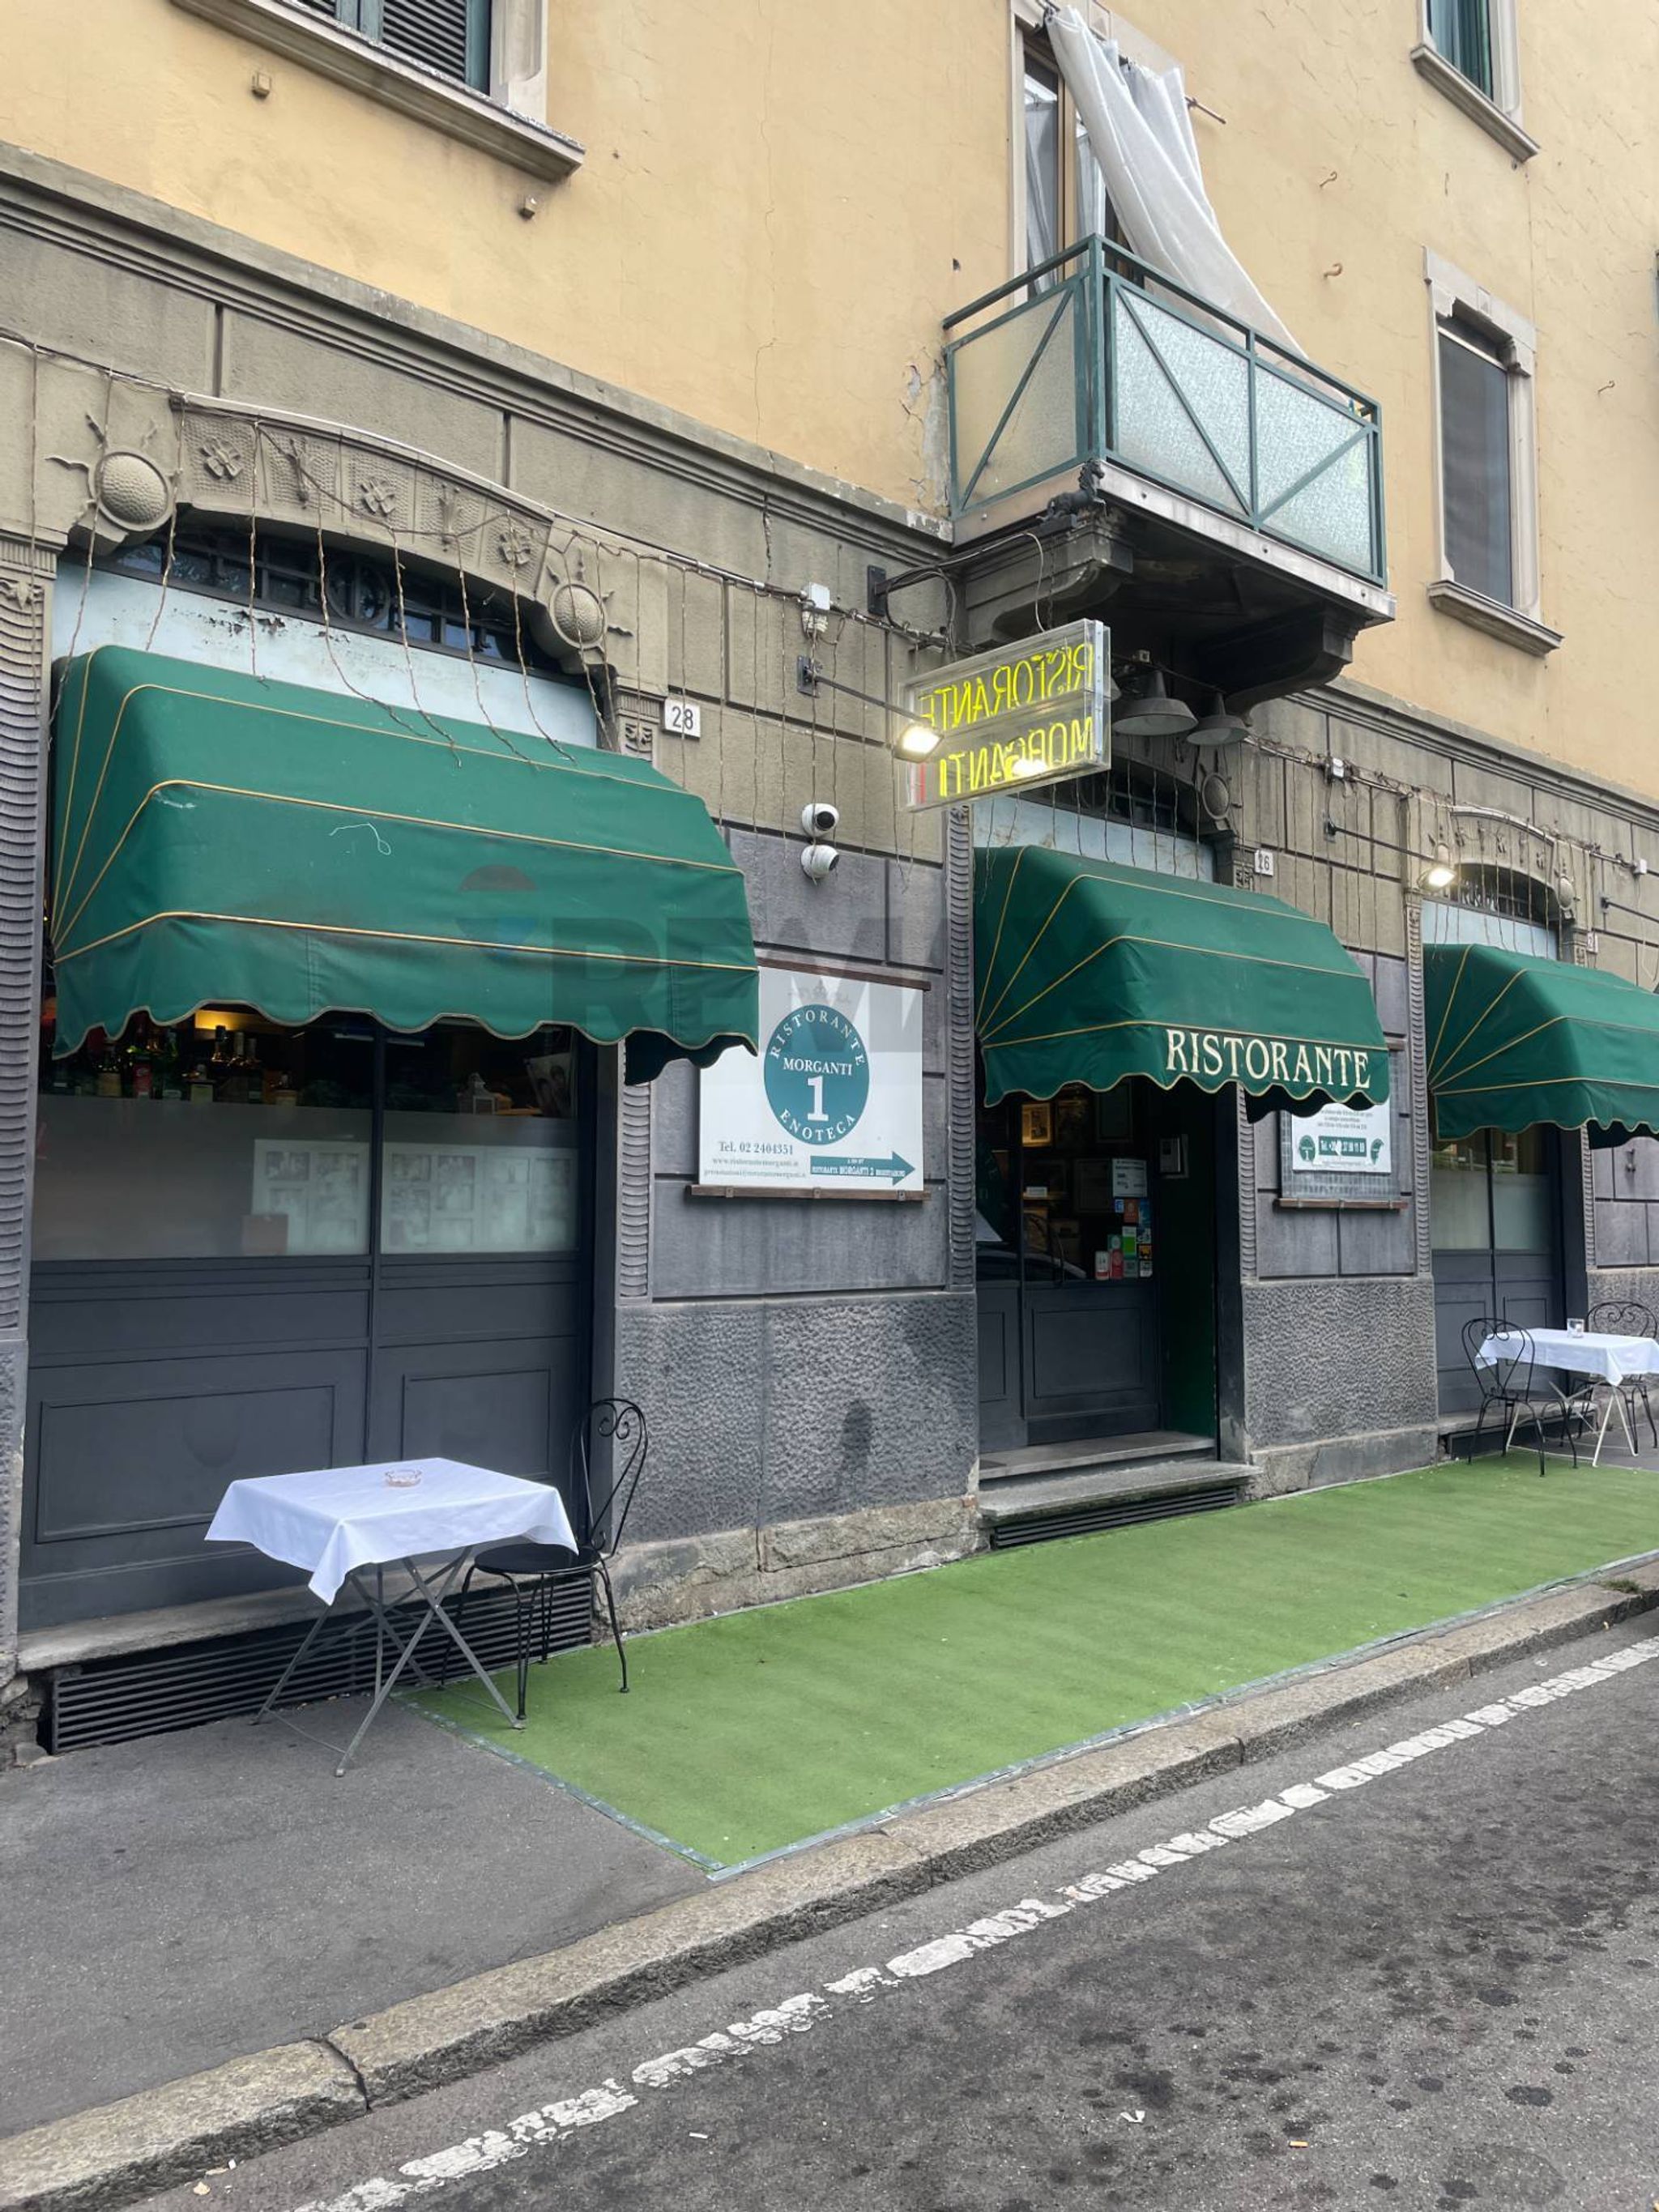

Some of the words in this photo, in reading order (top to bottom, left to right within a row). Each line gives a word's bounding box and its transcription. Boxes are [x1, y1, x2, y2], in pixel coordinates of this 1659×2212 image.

[672, 706, 693, 729] 28
[770, 1009, 866, 1066] RISTORANTE
[783, 1057, 852, 1076] MORGANTI
[1166, 1029, 1371, 1089] RISTORANTE
[807, 1075, 830, 1122] 1
[779, 1109, 855, 1142] ENOTECA
[719, 1141, 736, 1152] Tel.
[740, 1142, 751, 1153] 02
